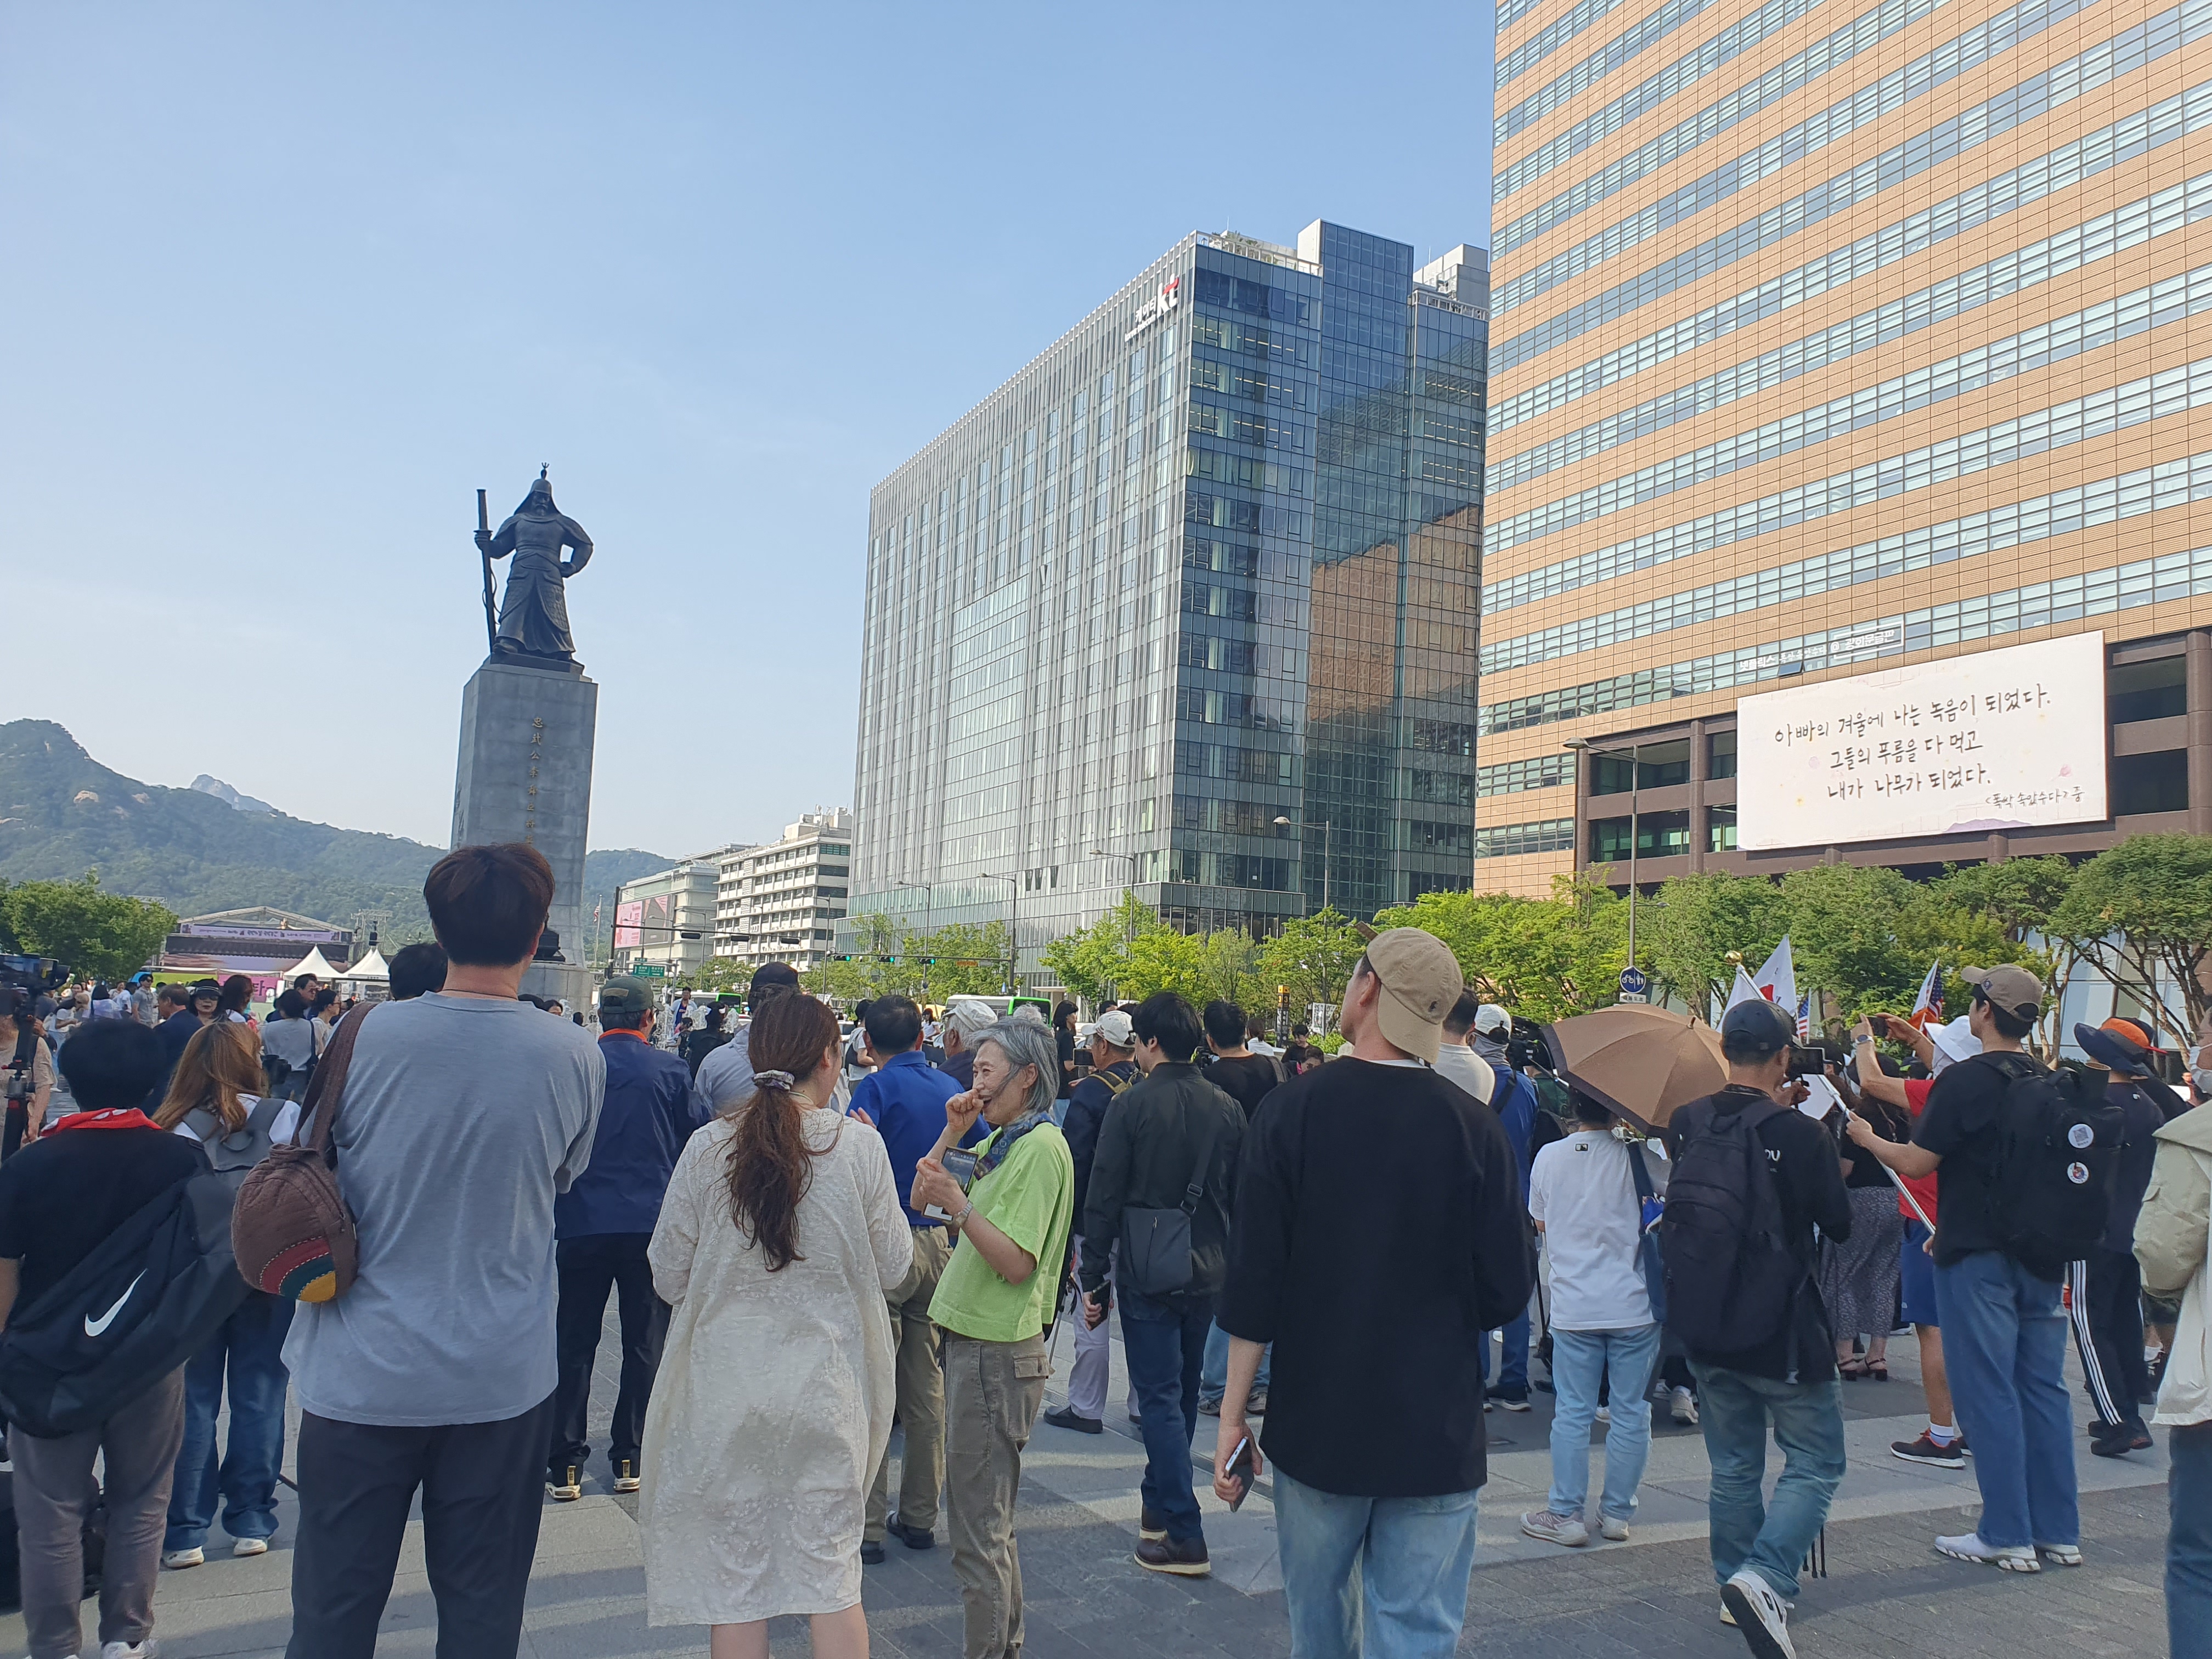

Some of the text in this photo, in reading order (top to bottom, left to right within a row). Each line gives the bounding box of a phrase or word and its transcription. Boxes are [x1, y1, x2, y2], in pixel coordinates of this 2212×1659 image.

[1135, 295, 1156, 323] 케이티
[1157, 273, 1179, 319] kt
[1740, 655, 1776, 672] 넷플릭스
[1844, 629, 1895, 651] 광화문글판
[1775, 683, 2051, 747] 아빠의 겨울에 나는 녹음이 되었다.
[1830, 731, 1984, 770] 그들의 푸름을 다 먹고
[1827, 763, 1992, 800] 내가 나무가 되었다.
[2072, 786, 2085, 802] 중
